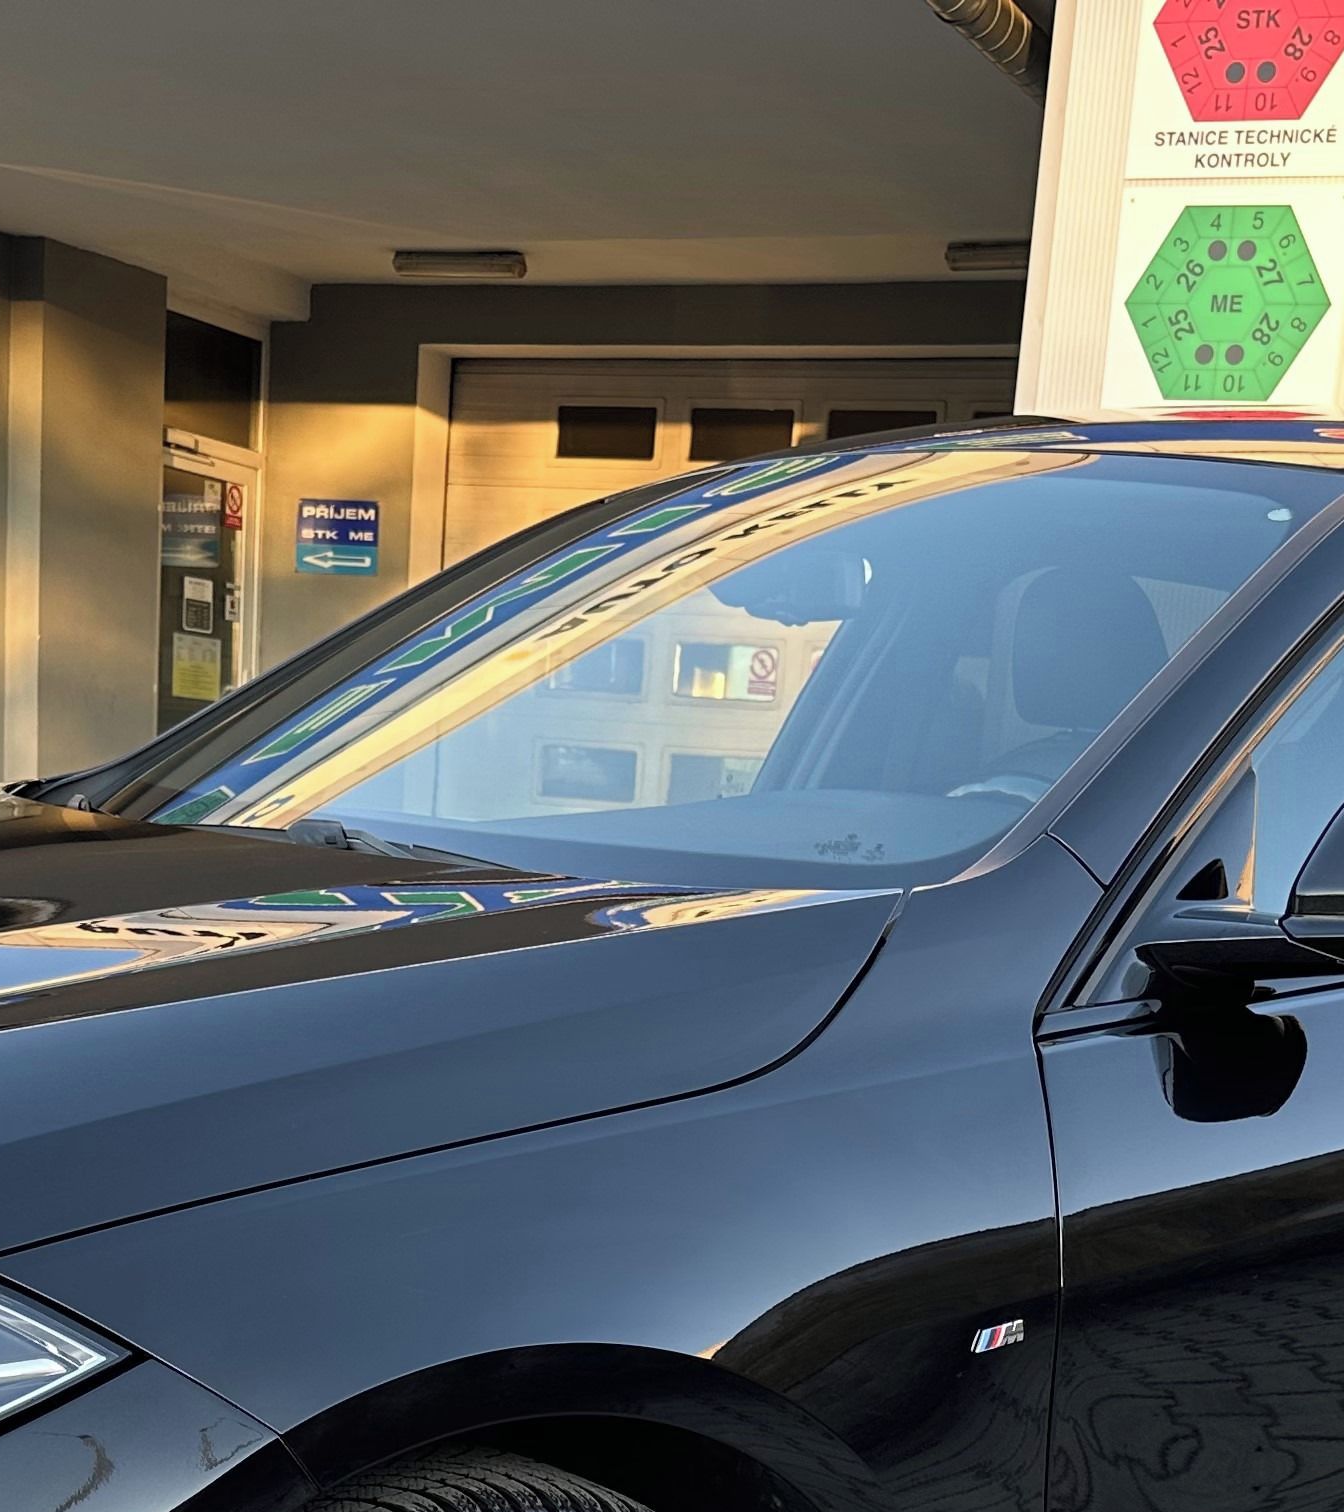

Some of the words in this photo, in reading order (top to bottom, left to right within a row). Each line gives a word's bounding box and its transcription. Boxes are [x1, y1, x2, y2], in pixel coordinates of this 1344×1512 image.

[1236, 9, 1281, 29] STK
[1197, 26, 1226, 60] 25
[1283, 26, 1313, 61] 28
[1323, 30, 1341, 46] 8
[1255, 92, 1278, 111] 10
[1154, 131, 1229, 147] STANICE
[1236, 125, 1338, 145] TECHNICKÉ
[1194, 152, 1292, 169] KONTROLY
[1210, 213, 1222, 231] 4
[1252, 211, 1264, 230] 5
[1176, 259, 1205, 292] 26
[1256, 258, 1284, 288] 27
[1210, 294, 1243, 313] ME
[1168, 308, 1195, 341] 25
[1251, 312, 1280, 346] 28
[1290, 317, 1307, 332] 8
[1223, 374, 1245, 392] 10
[302, 504, 376, 521] PŘÍJEM
[301, 529, 339, 540] STK
[349, 532, 374, 542] ME
